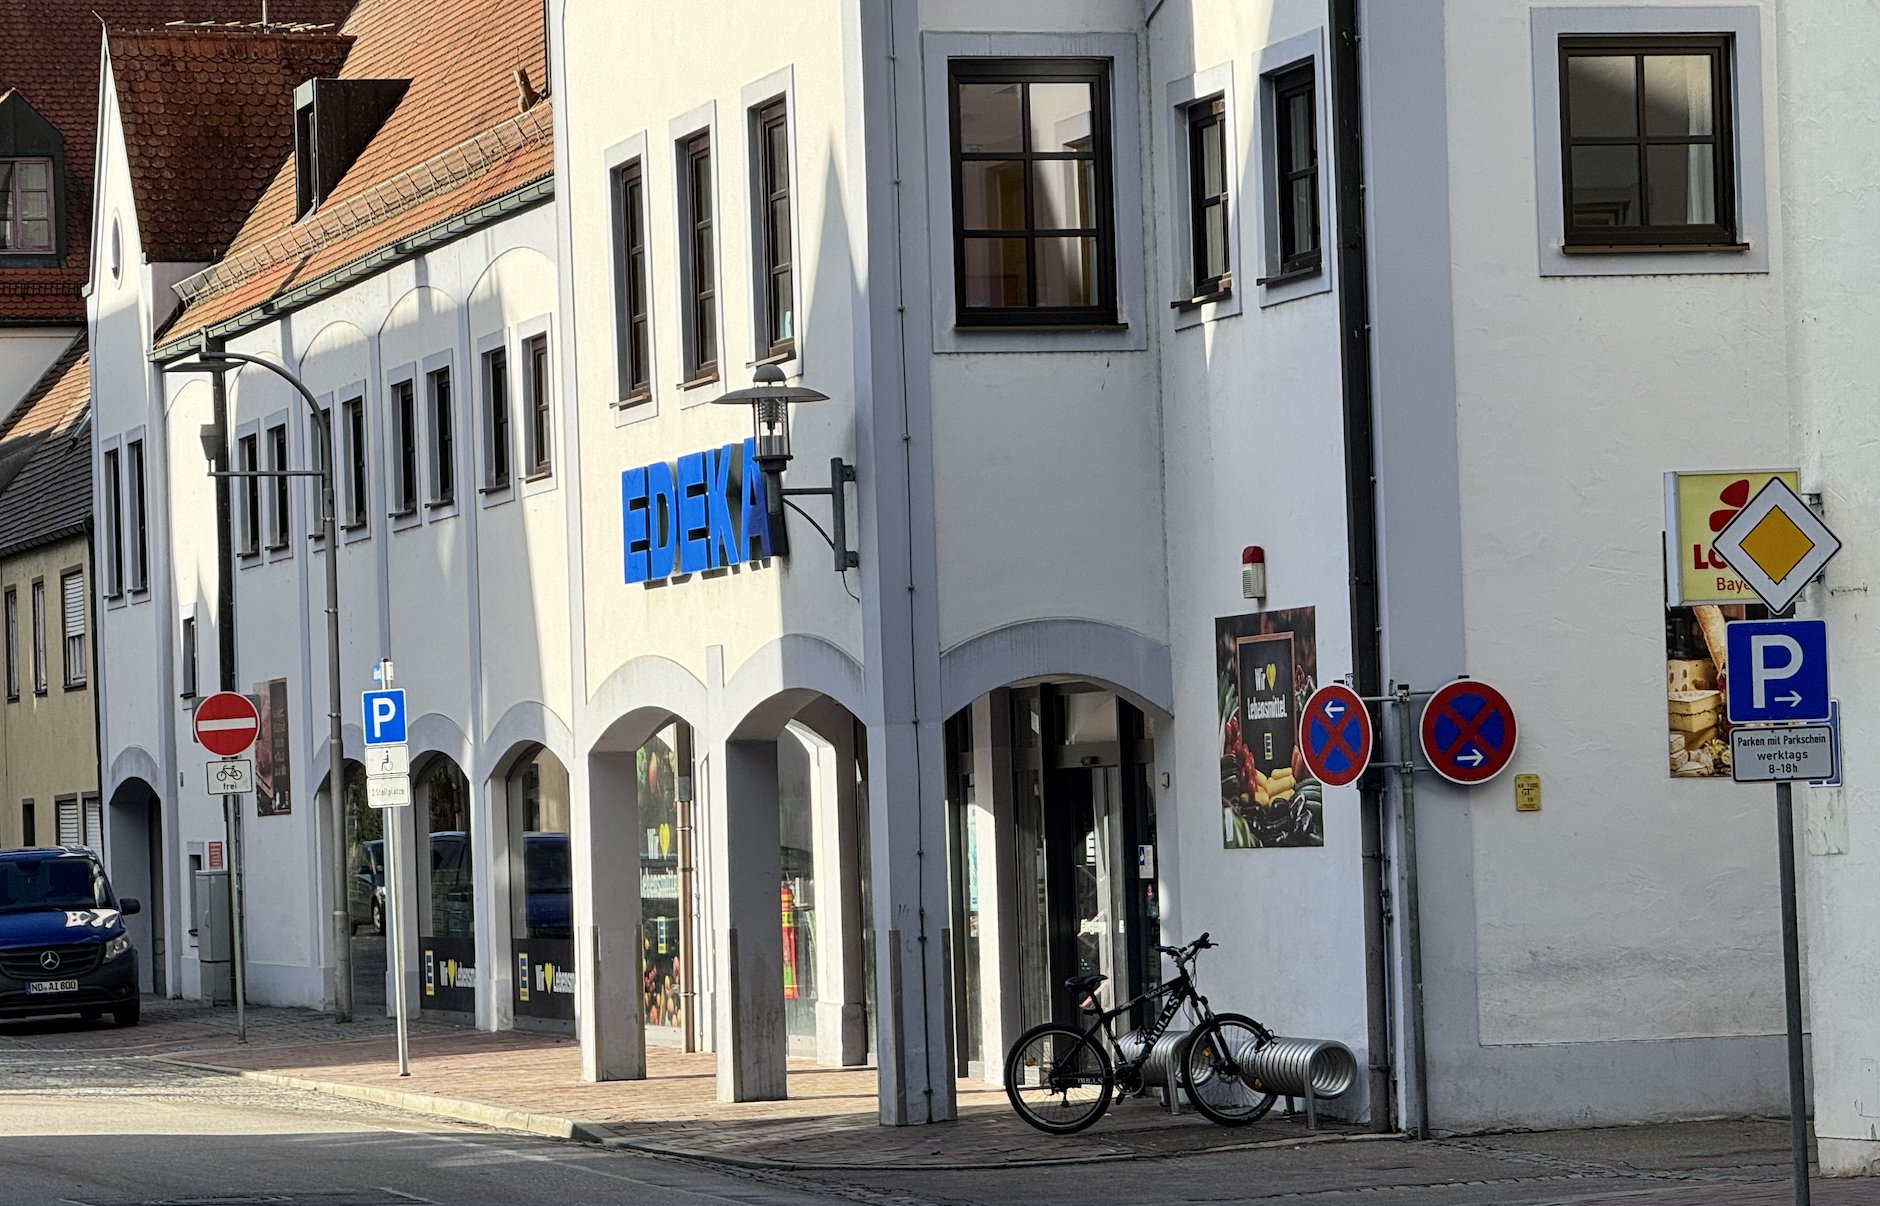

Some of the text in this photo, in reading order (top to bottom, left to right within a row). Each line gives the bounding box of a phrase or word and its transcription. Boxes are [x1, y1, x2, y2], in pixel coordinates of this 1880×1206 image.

[622, 437, 771, 585] EDEKA
[1254, 667, 1266, 691] Wir
[1751, 634, 1804, 709] P
[372, 698, 396, 738] P
[1737, 734, 1826, 747] Parken mit Parkschein
[1757, 750, 1808, 761] werktags
[1768, 763, 1798, 774] 8-18h
[223, 781, 238, 790] frei
[31, 983, 43, 992] ND
[1148, 995, 1180, 1046] BULLS
